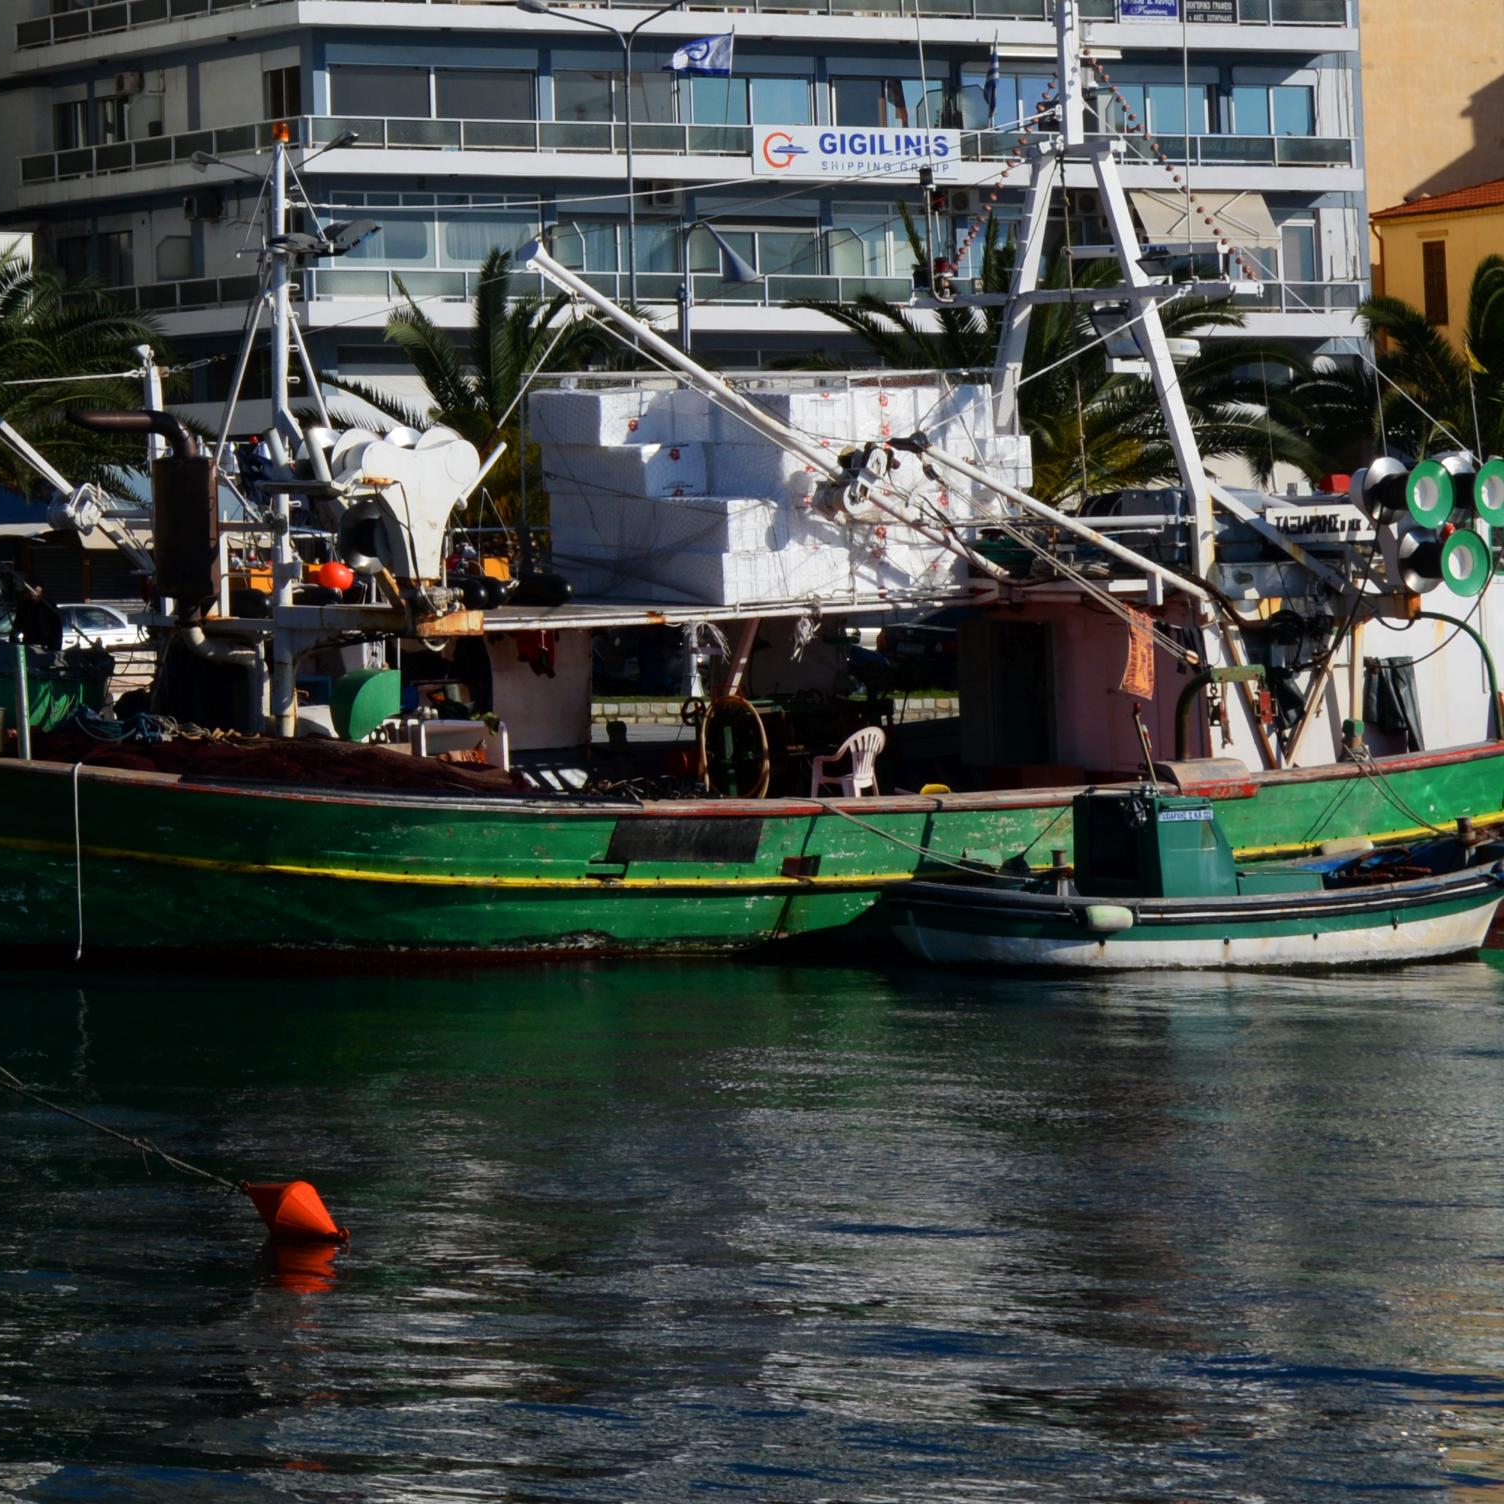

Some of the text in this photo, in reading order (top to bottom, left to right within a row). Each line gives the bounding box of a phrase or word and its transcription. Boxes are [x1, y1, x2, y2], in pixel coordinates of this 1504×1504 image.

[819, 133, 949, 157] GIGILINIS
[821, 161, 950, 173] SHIPPING GROUP
